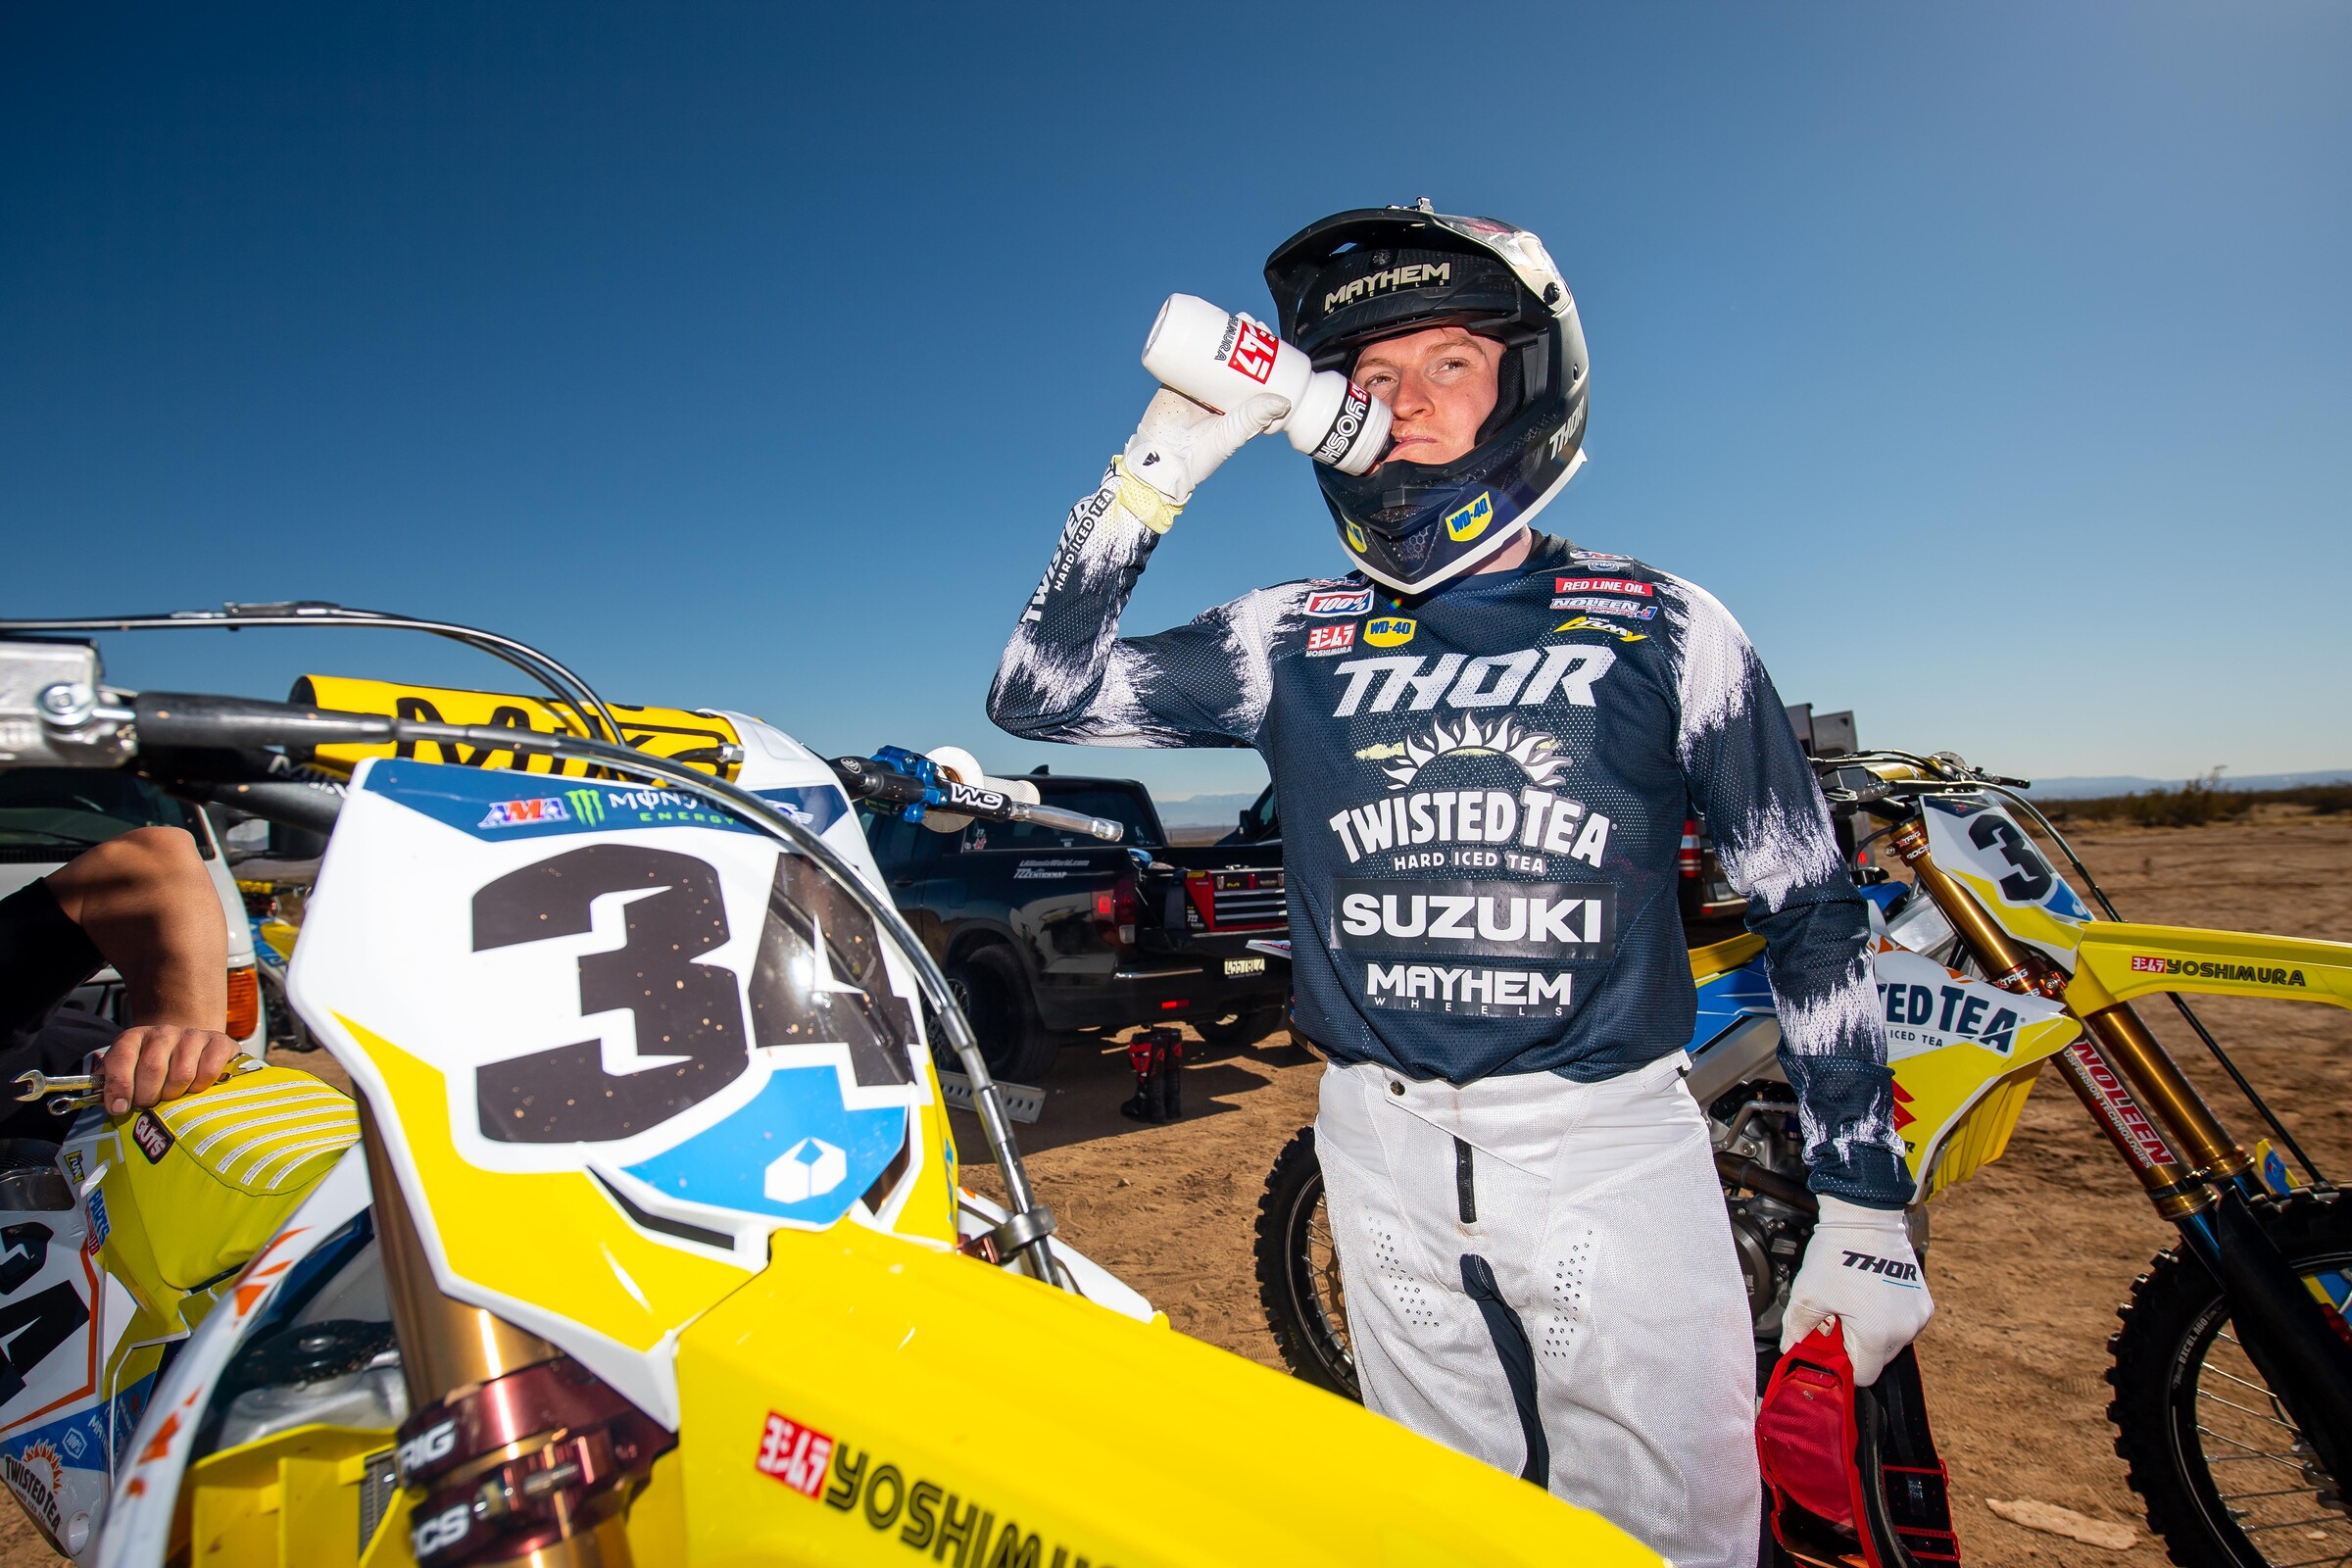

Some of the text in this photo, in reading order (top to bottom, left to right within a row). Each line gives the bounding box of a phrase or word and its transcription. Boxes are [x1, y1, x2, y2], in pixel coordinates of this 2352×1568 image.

[1324, 262, 1450, 312] MAYHEM
[1548, 395, 1586, 462] THOR
[1450, 497, 1490, 534] WD-40
[1054, 554, 1076, 593] HARD
[1072, 516, 1095, 554] ICED
[1088, 488, 1116, 517] TEA
[1313, 593, 1368, 612] 100%
[1563, 580, 1646, 594] RED LINE OIL
[1552, 598, 1638, 612] NOLEEN
[1308, 625, 1353, 649] ヨシムラ
[1369, 620, 1412, 635] WD-40
[1304, 646, 1352, 658] YOSHIMURA
[1333, 644, 1617, 717] THOR
[477, 797, 572, 830] AMA
[638, 809, 735, 826] ENERGY
[1329, 789, 1612, 869] TWISTED TEA
[1394, 852, 1546, 874] HARD ICED TEA
[1342, 892, 1602, 944] SUZUKI
[1366, 962, 1572, 1005] MAYHEM
[2132, 956, 2307, 988] ヨシムラ YOSHIMURA
[1374, 996, 1563, 1017] WHEELS
[1938, 984, 2019, 1054] TEA
[1889, 1029, 1944, 1048] ICED TEA
[2071, 1040, 2178, 1165] NOLEEN
[135, 1114, 168, 1159] GUTS
[2099, 1100, 2153, 1169] TECHNOLOGIES
[88, 1187, 111, 1247] PARTS
[1840, 1250, 1918, 1283] THOR
[65, 1433, 85, 1454] 100%
[4, 1455, 63, 1535] TWISTED TEA
